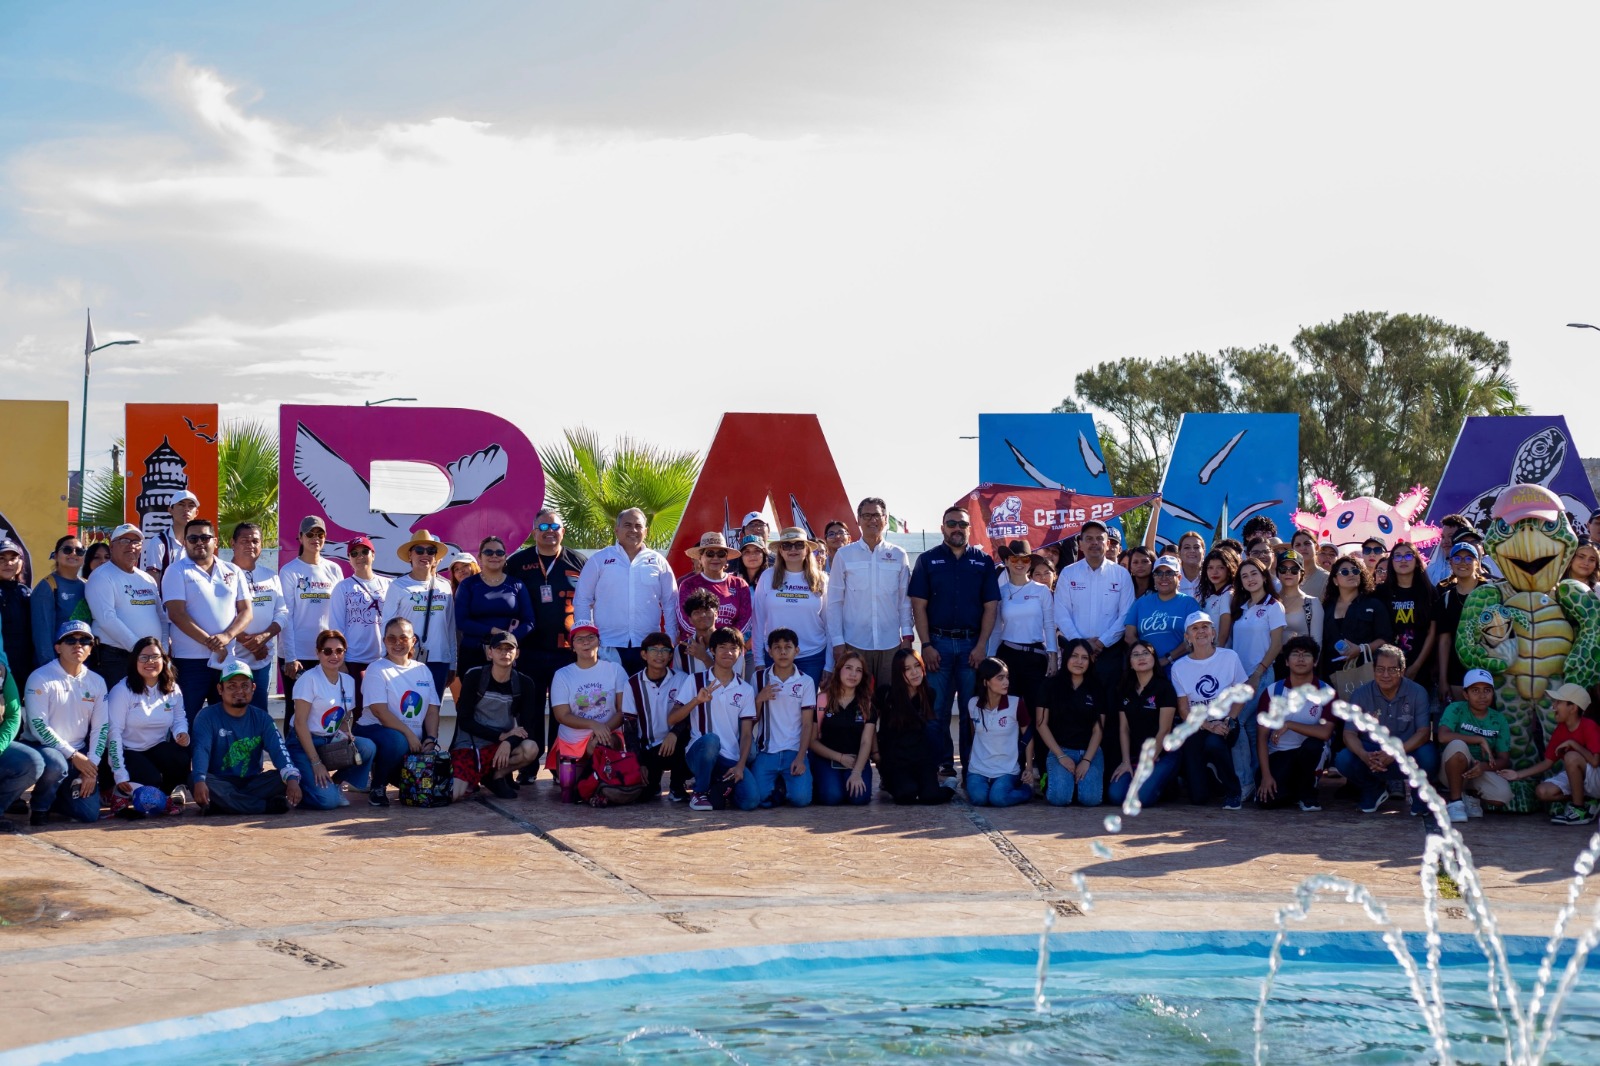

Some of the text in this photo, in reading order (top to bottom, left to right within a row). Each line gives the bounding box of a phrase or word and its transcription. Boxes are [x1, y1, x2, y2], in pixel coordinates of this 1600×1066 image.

[1033, 502, 1114, 527] CETIS 22
[988, 526, 1013, 537] CETIS
[1014, 525, 1027, 534] 22
[1460, 722, 1499, 737] MINECRAFT
